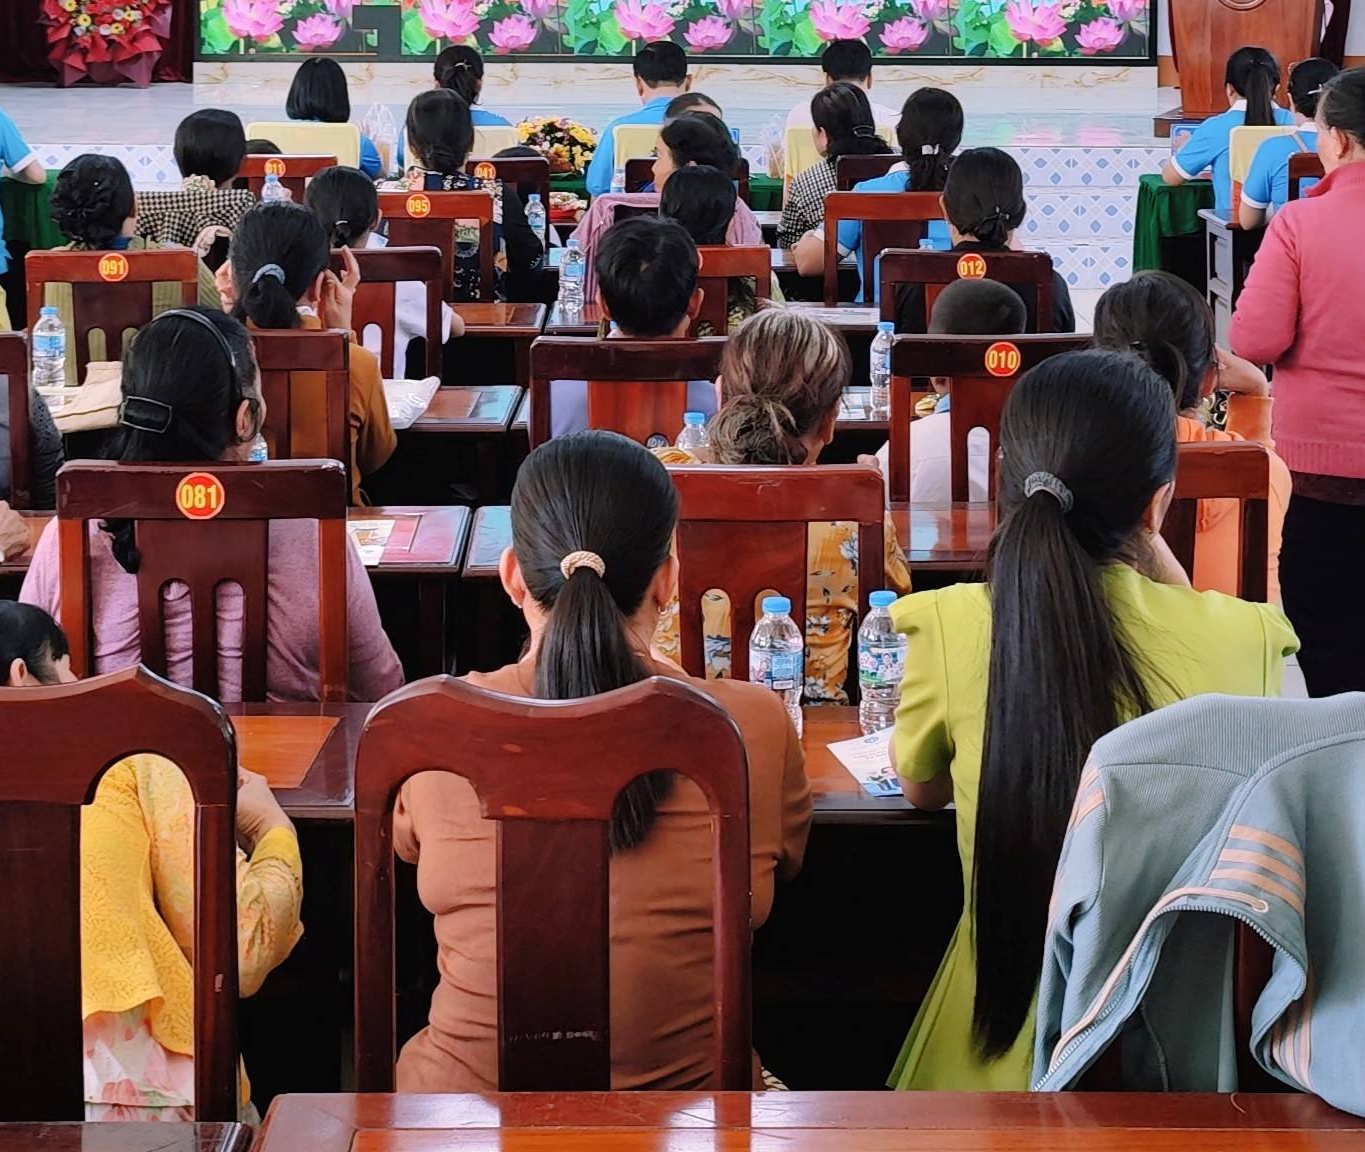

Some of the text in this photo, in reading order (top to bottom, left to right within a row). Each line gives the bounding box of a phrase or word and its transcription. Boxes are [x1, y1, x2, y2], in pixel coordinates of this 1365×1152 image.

[409, 199, 428, 212] 095
[102, 259, 125, 275] 091
[960, 260, 983, 276] 012
[990, 351, 1017, 369] 010
[180, 484, 218, 508] 081
